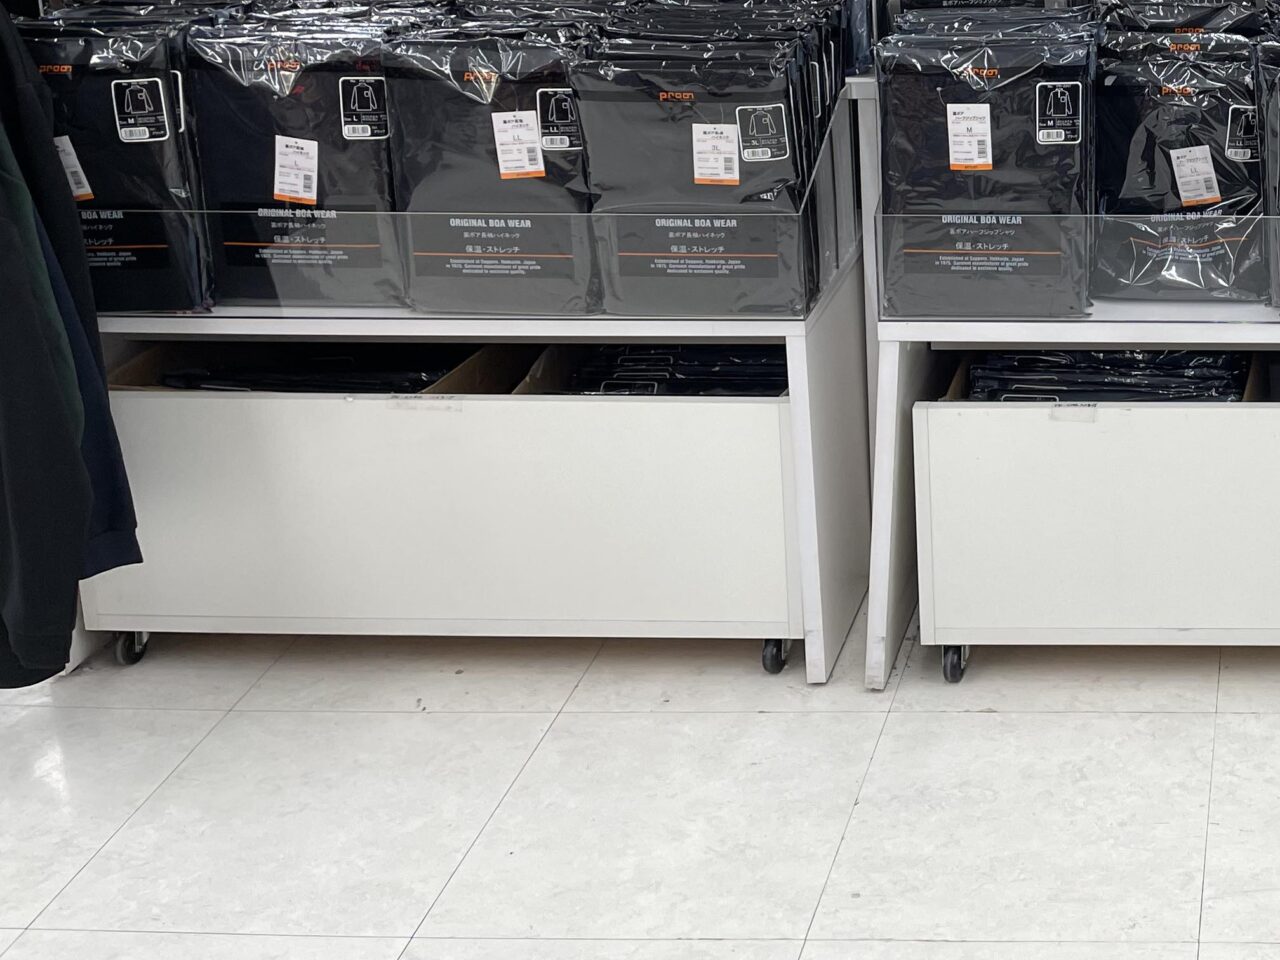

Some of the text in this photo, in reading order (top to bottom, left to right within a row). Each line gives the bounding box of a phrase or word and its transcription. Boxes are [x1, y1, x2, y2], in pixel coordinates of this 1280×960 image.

[449, 218, 532, 228] ORIGINAL BOA WEAR
[655, 218, 737, 228] ORIGINAL BOA WEAR
[942, 214, 1022, 225] ORIGINAL BOA WEAR
